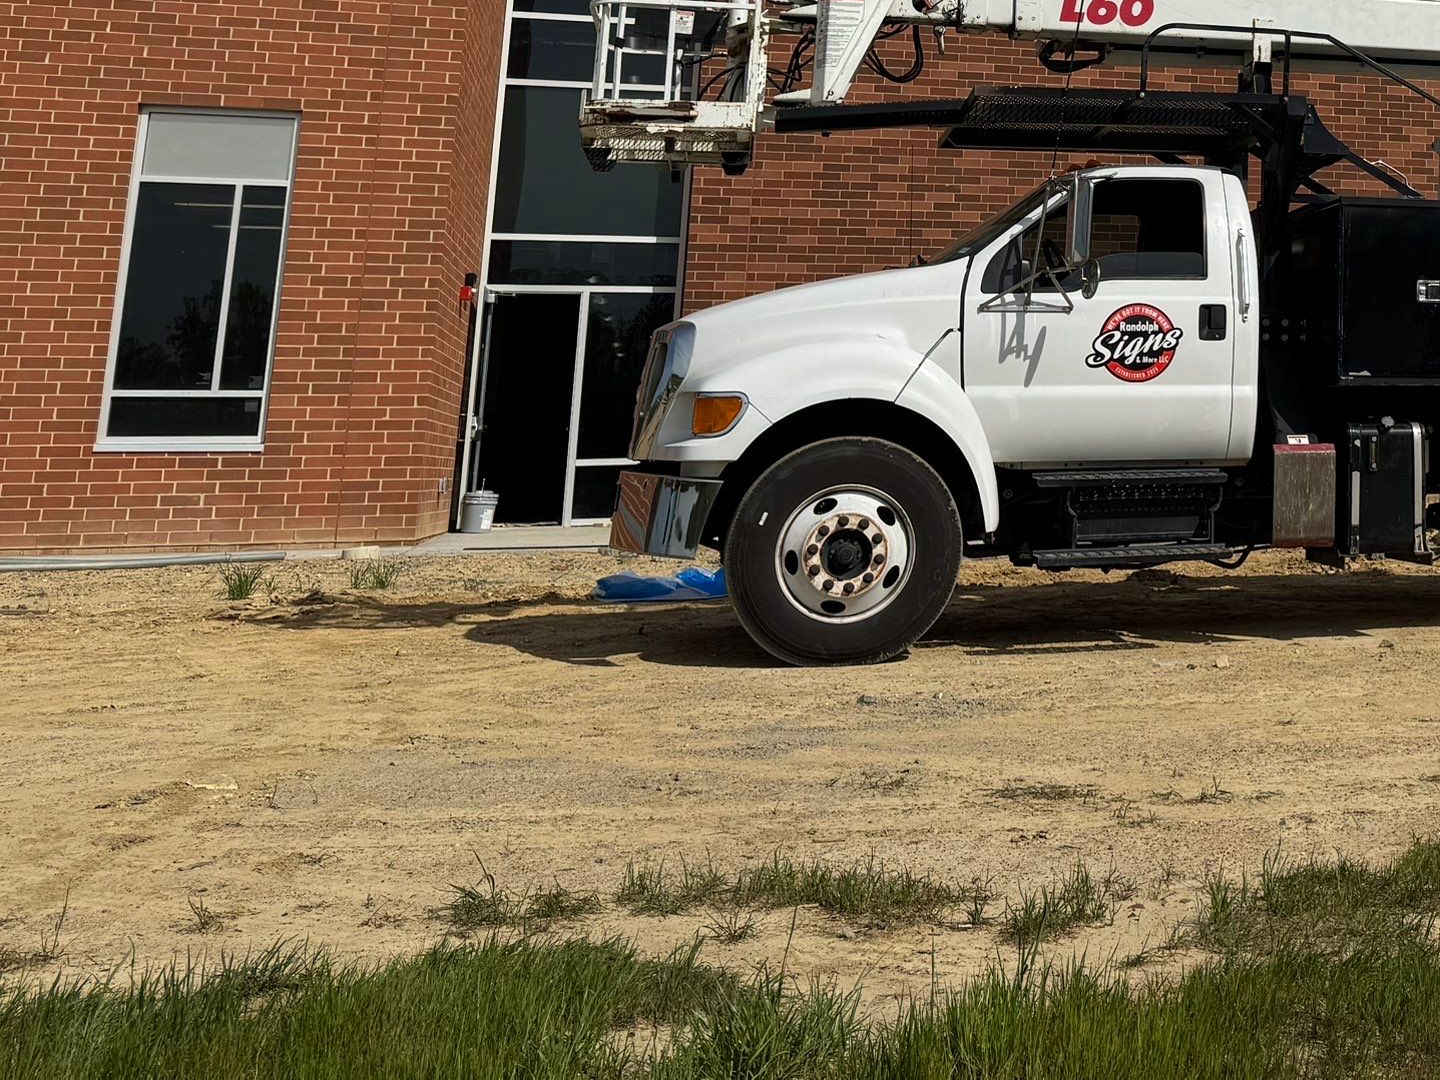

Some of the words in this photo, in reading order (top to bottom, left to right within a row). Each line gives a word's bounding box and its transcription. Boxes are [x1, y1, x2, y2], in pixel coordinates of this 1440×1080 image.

[1122, 307, 1133, 317] GOT
[1134, 306, 1141, 314] IT
[1141, 307, 1158, 318] FROM
[1119, 320, 1159, 334] Randolph
[1087, 329, 1181, 365] Signs
[1141, 355, 1158, 364] More
